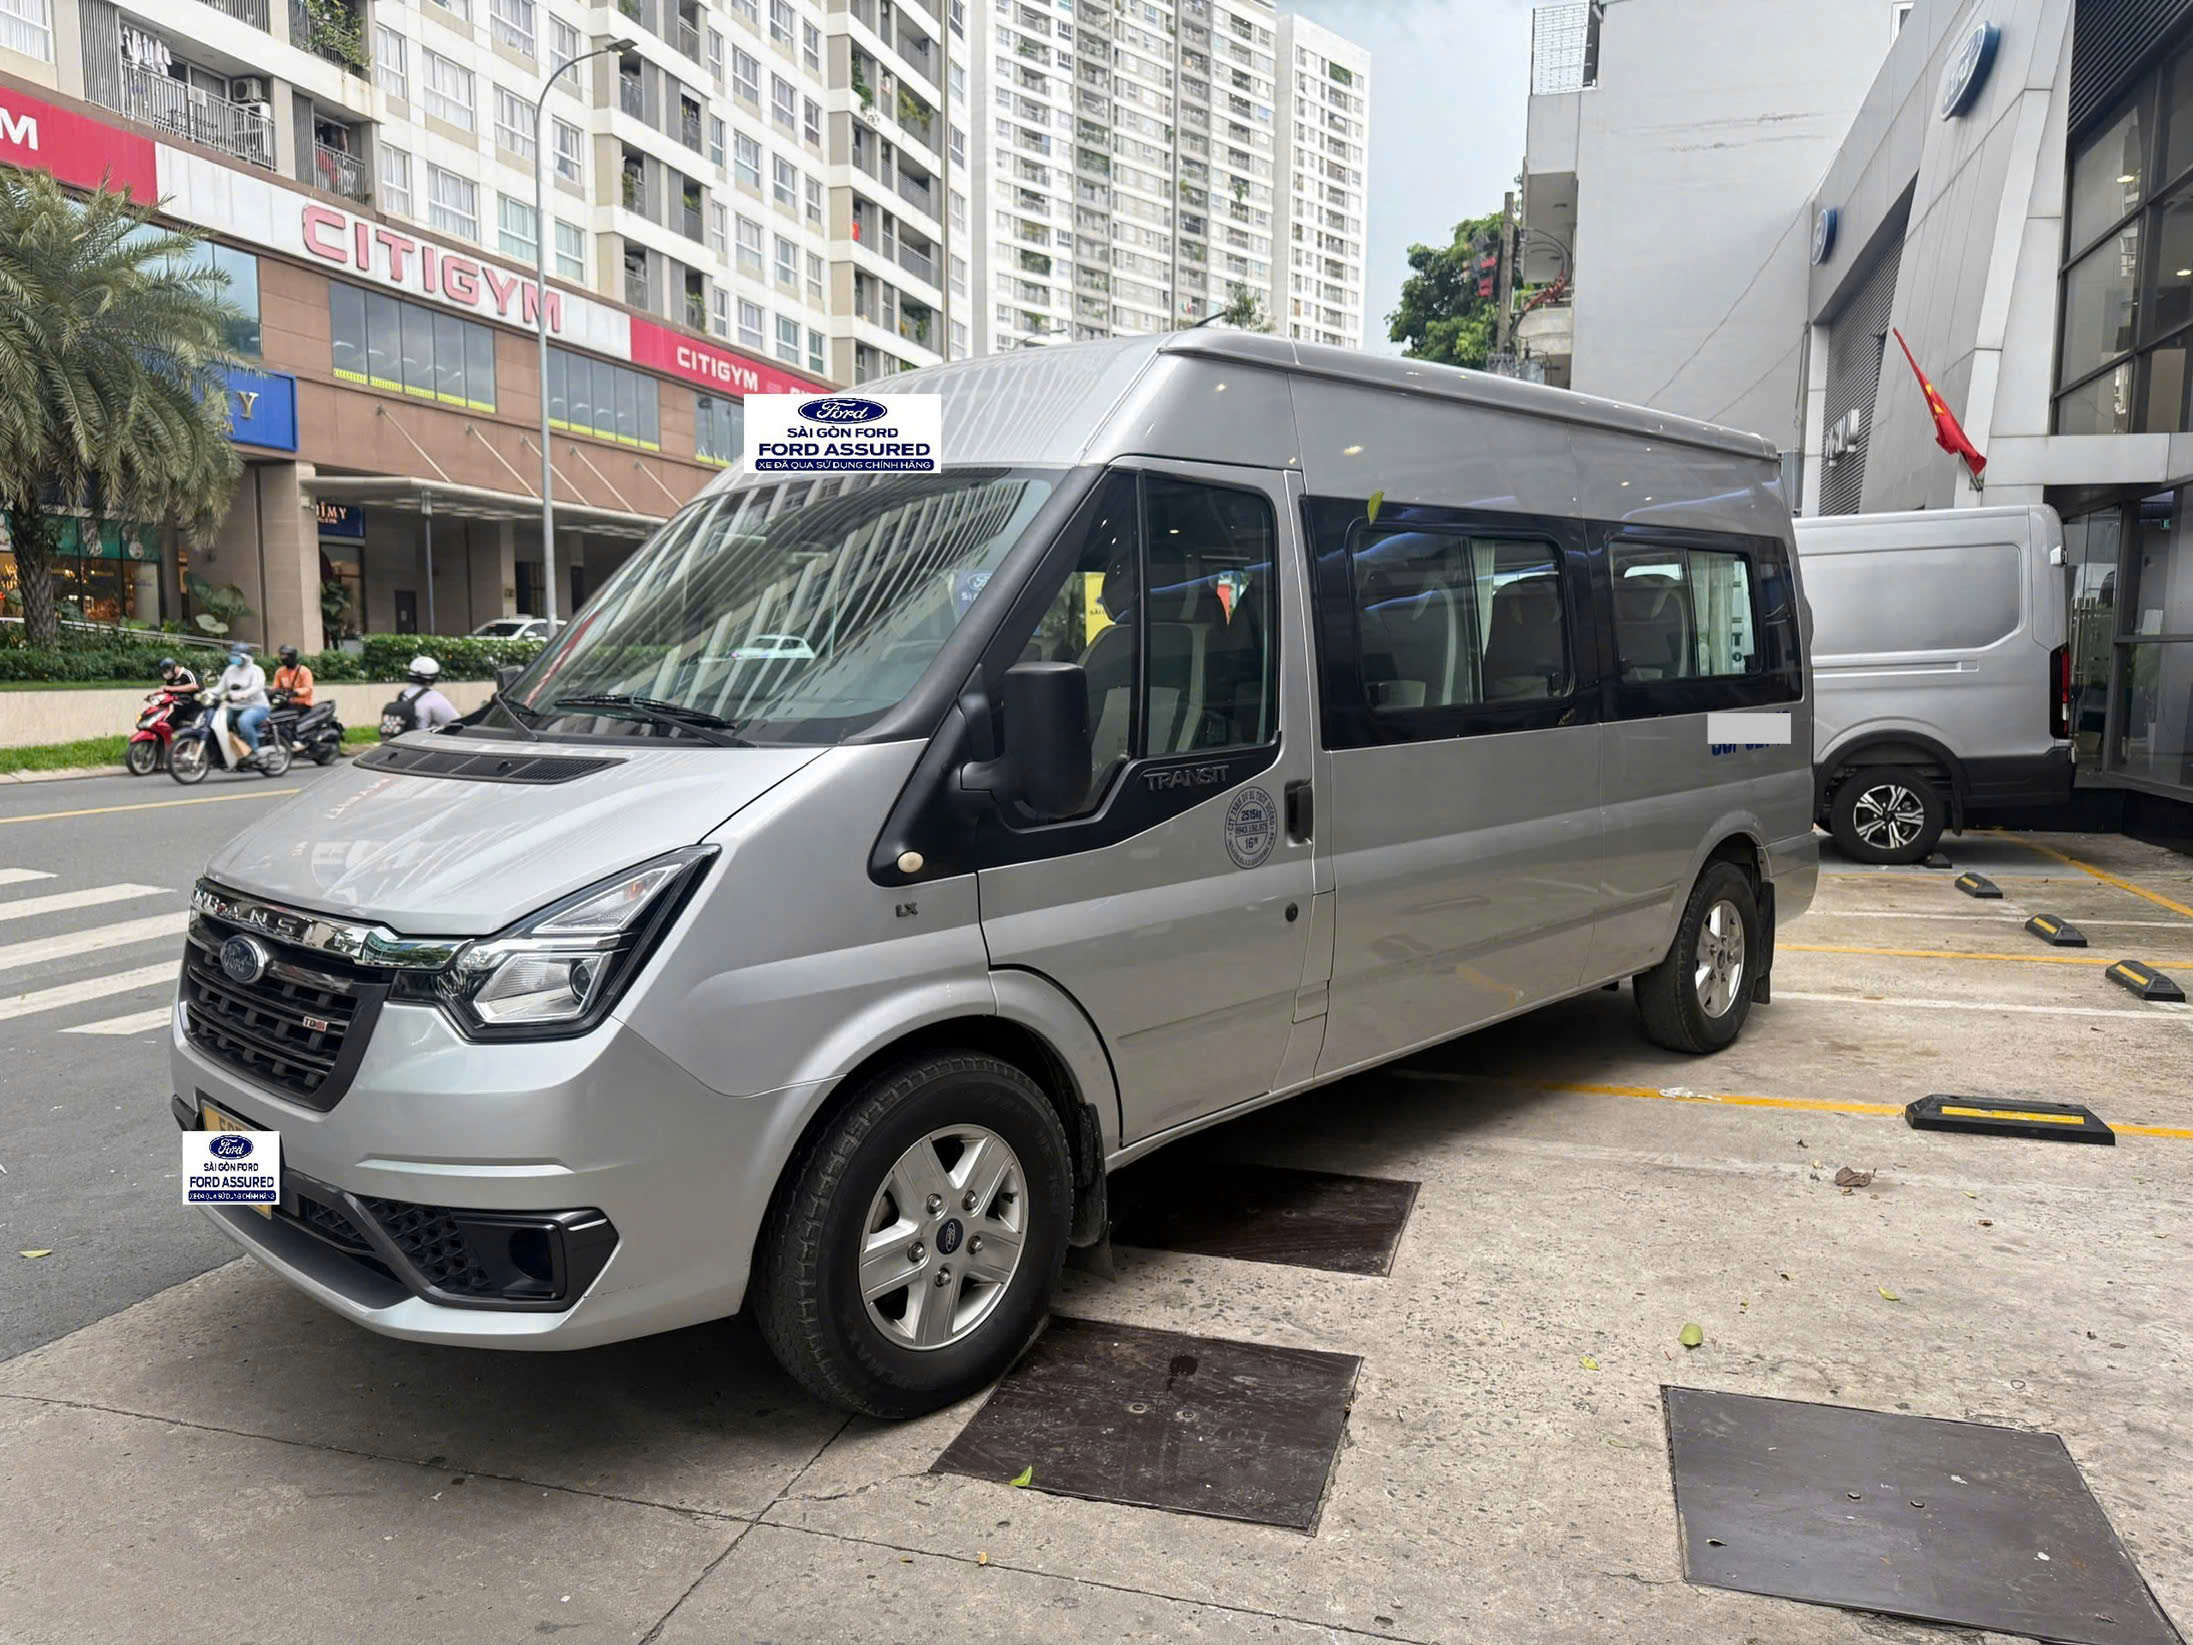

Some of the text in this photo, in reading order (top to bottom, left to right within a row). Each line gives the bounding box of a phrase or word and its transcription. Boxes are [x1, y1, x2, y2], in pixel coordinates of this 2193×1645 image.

[302, 204, 561, 333] CITIGYM
[676, 346, 759, 392] CITIGYM
[1143, 766, 1229, 792] TRANSIT
[896, 902, 919, 918] LX
[223, 944, 250, 974] Ford
